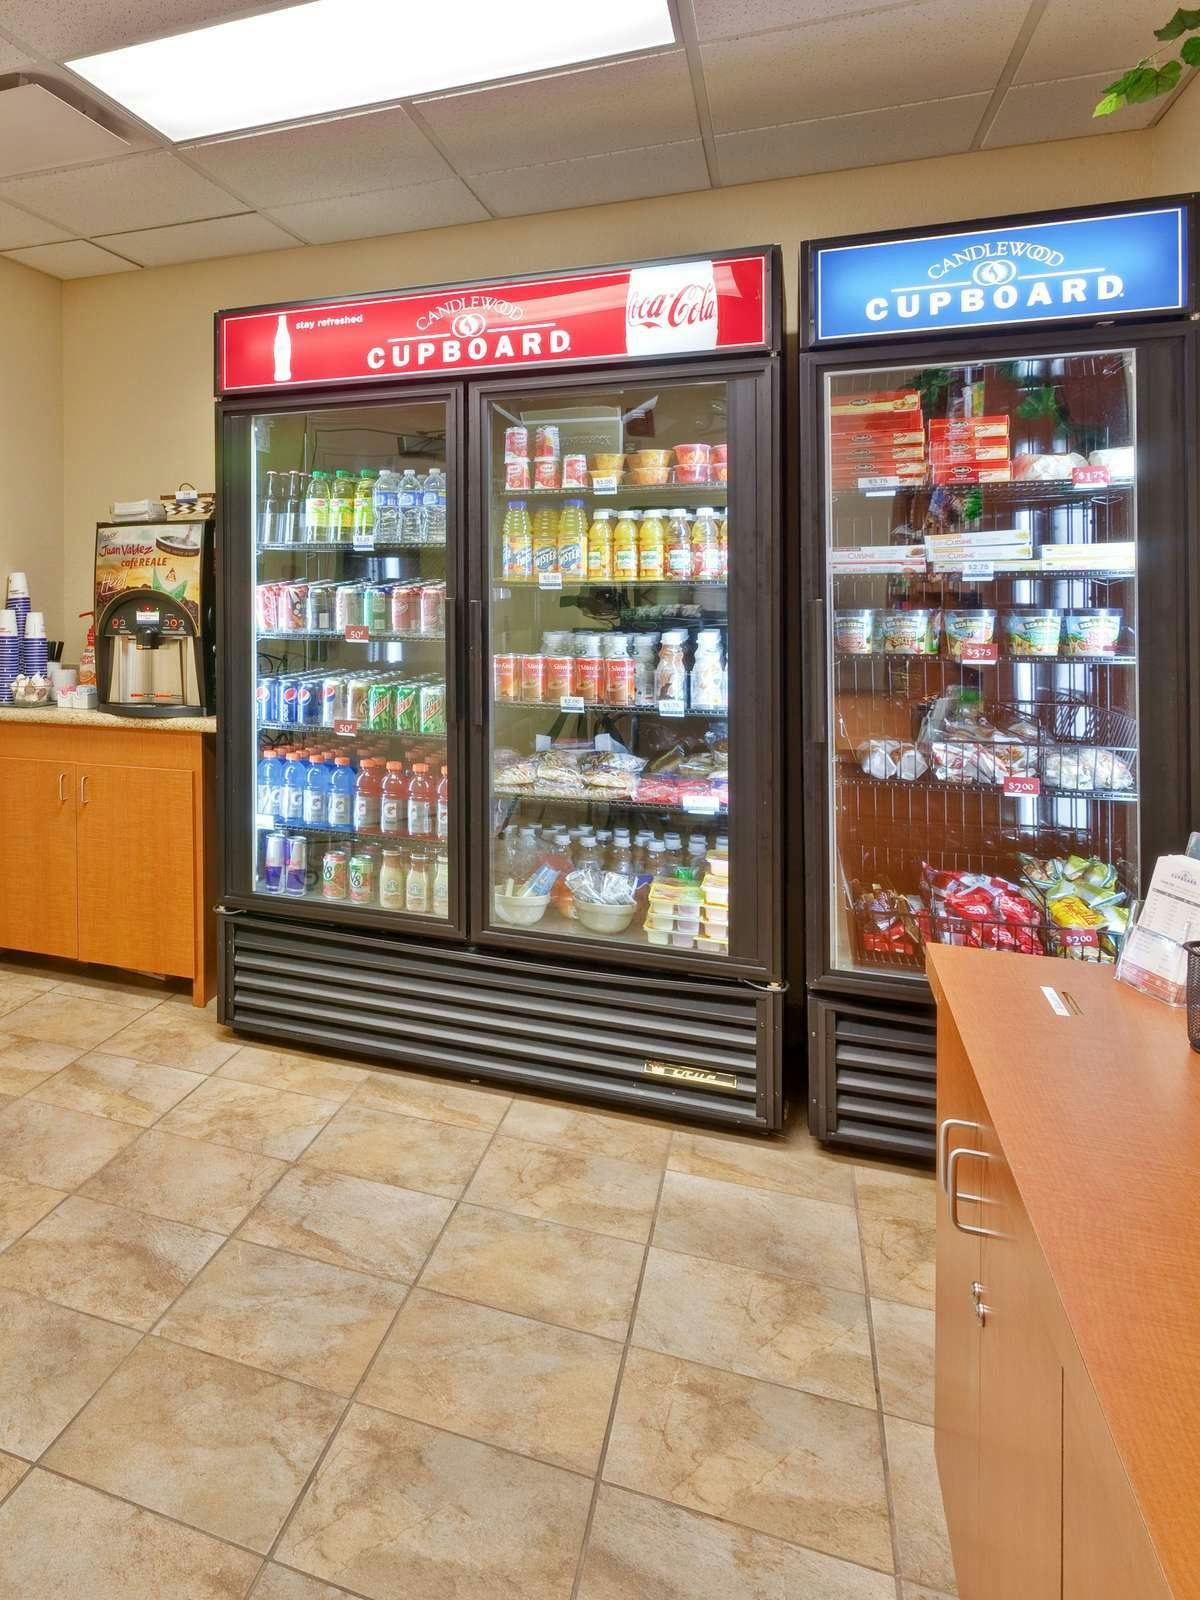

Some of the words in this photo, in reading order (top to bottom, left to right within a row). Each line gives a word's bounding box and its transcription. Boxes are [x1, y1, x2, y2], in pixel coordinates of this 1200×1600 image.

[928, 241, 1065, 280] CANDLEWOOD
[295, 320, 316, 330] stay
[317, 314, 364, 327] refreshed
[416, 295, 525, 330] CANDLEWOOD
[98, 544, 121, 557] Juan
